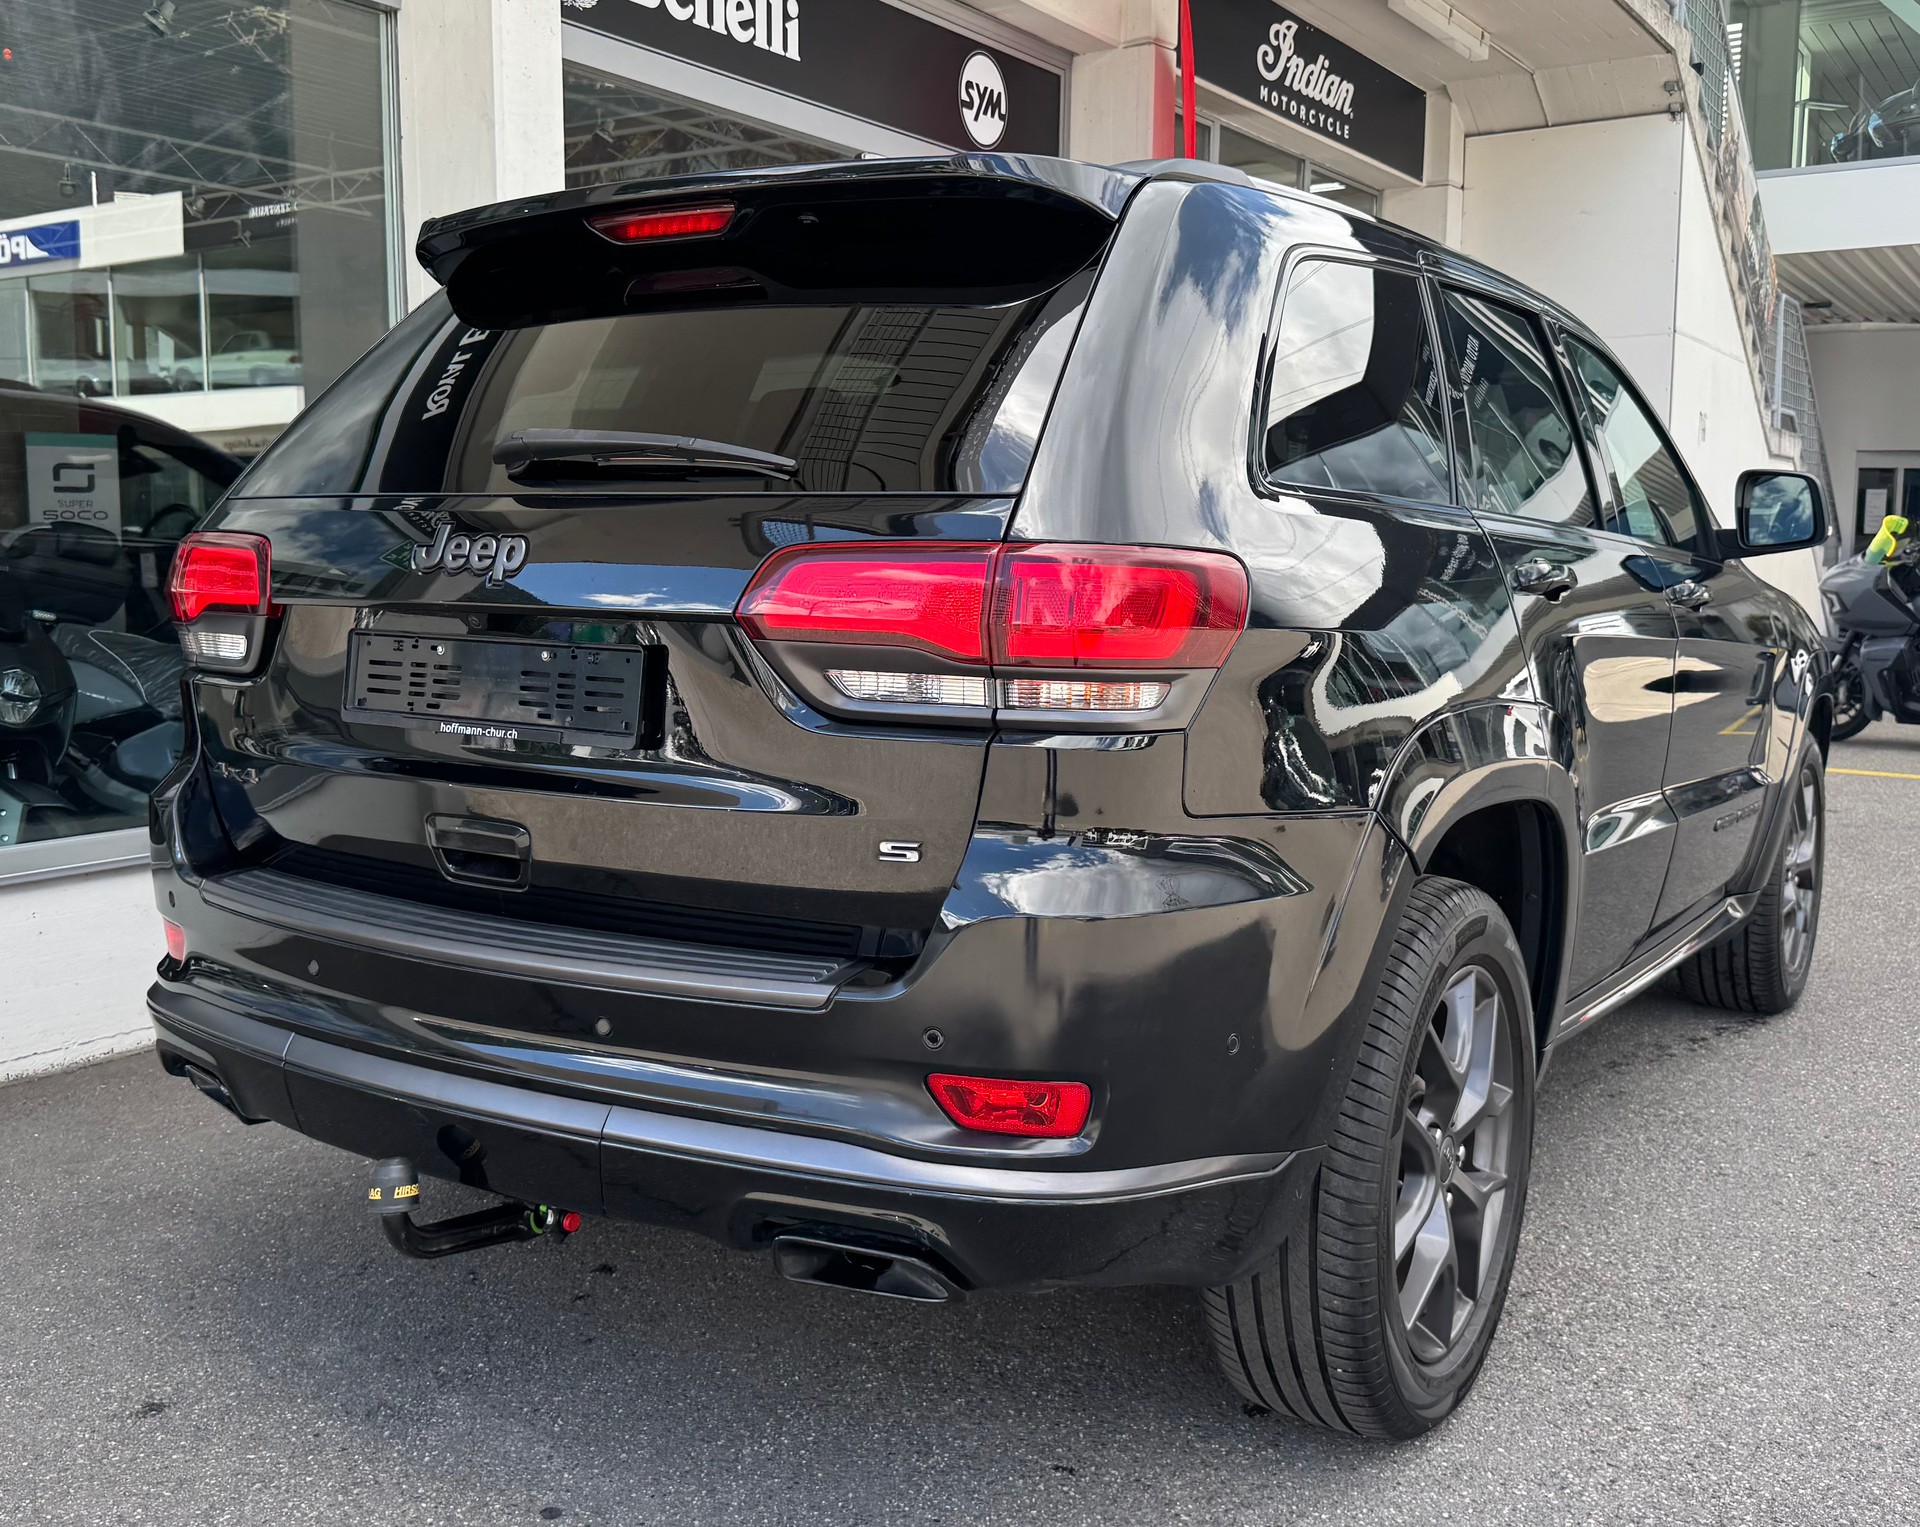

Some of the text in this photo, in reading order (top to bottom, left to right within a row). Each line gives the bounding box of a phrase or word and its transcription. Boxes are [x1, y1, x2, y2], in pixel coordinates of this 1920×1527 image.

[1257, 20, 1354, 116] Indian
[961, 80, 1006, 122] SYM
[1260, 85, 1350, 139] MOTORCYCLE
[43, 510, 108, 520] SOCO
[57, 500, 93, 509] SUPER
[411, 520, 530, 589] Jeep
[440, 721, 518, 740] hoffmann-chur.ch
[878, 840, 922, 863] S
